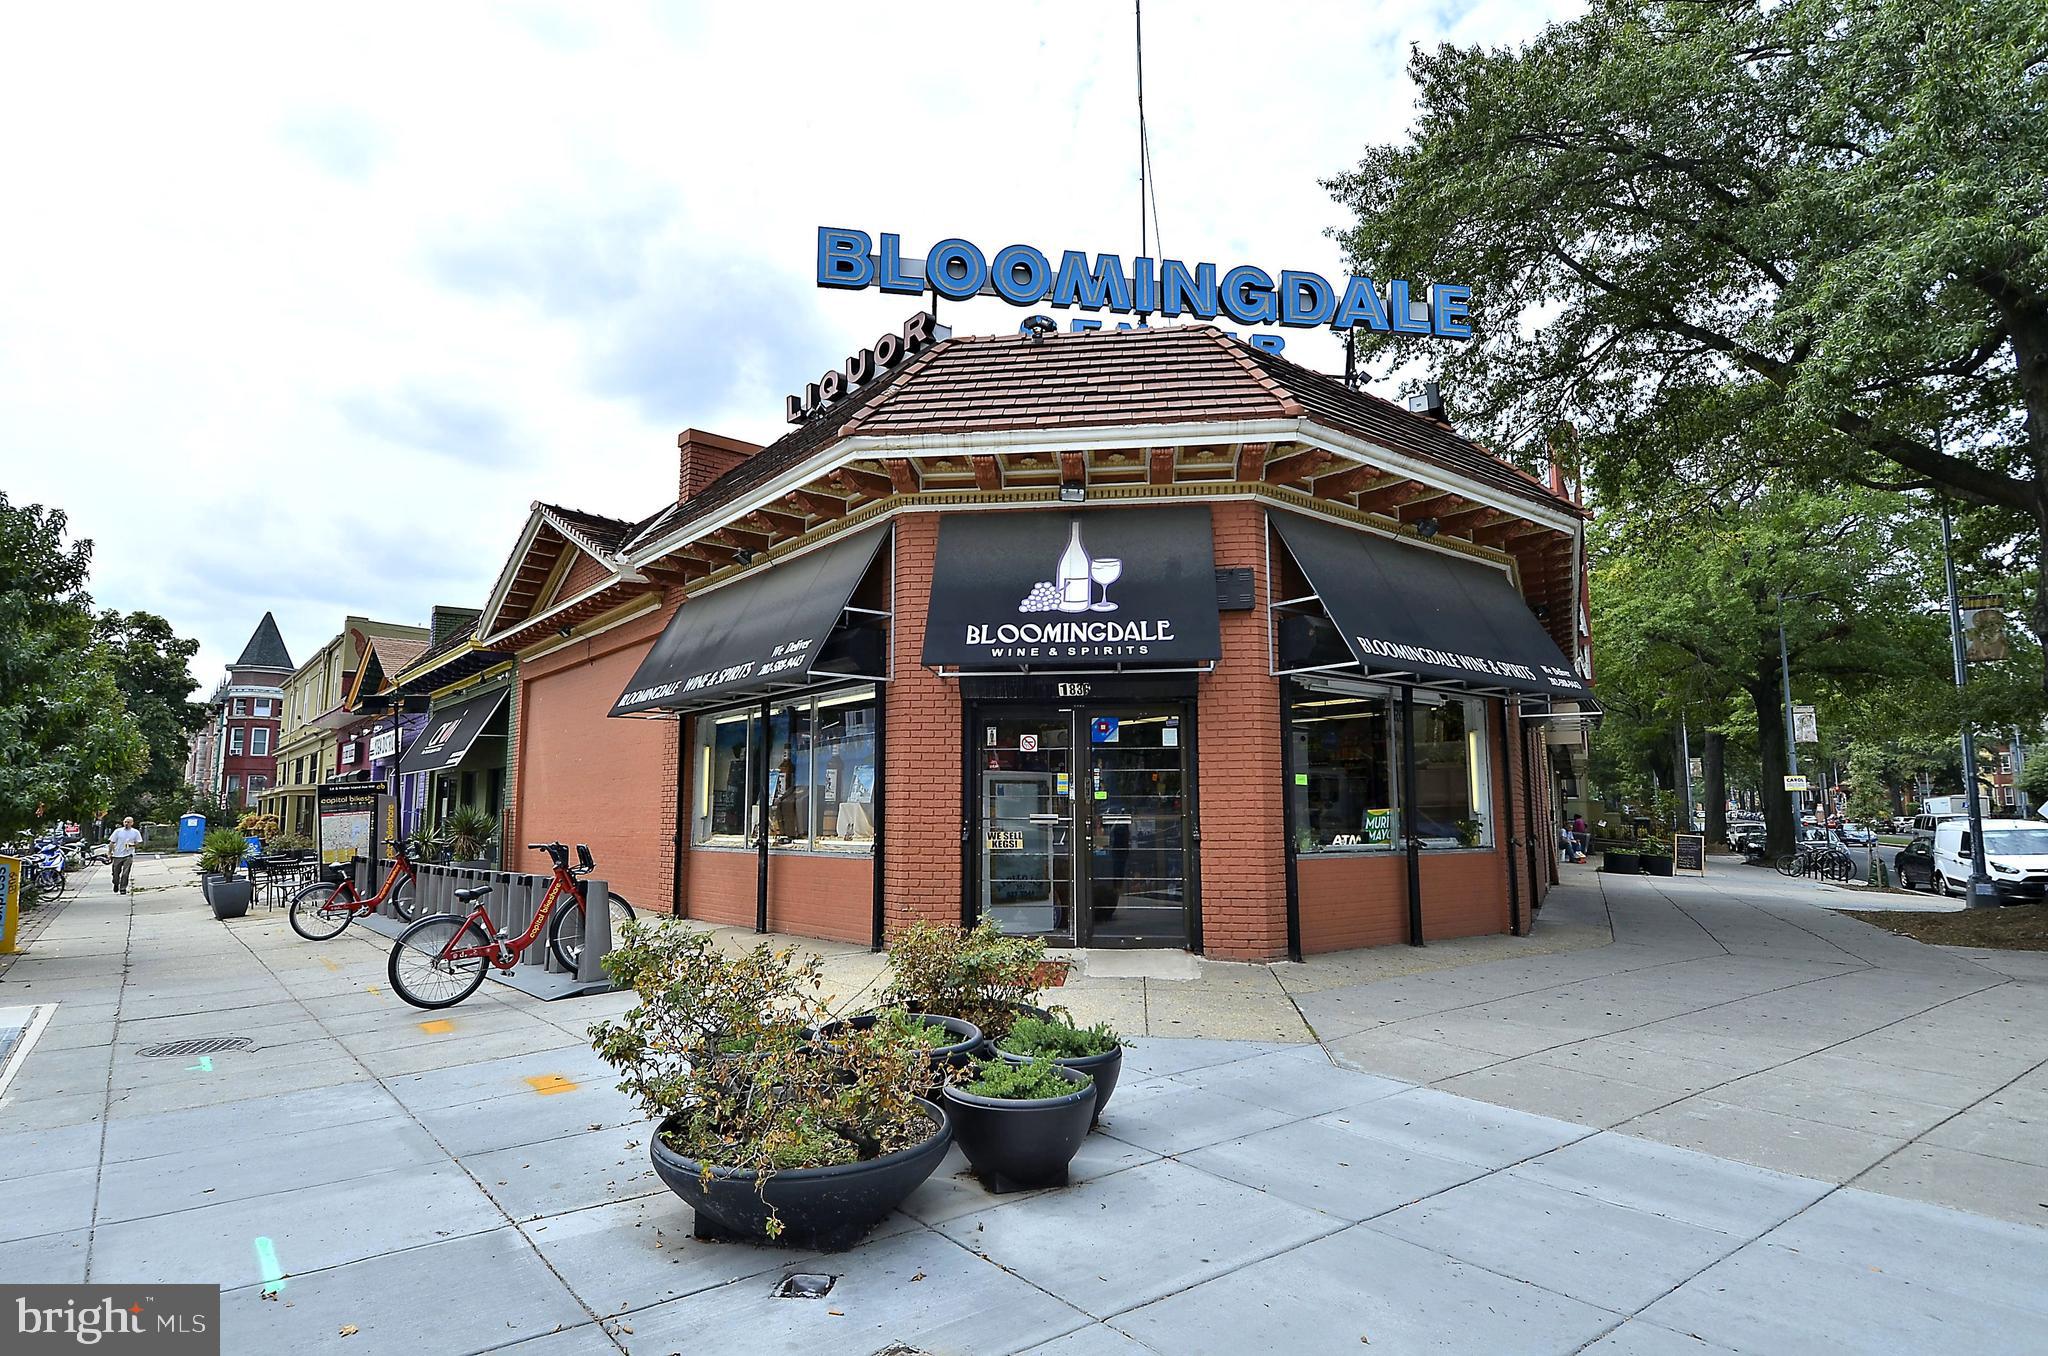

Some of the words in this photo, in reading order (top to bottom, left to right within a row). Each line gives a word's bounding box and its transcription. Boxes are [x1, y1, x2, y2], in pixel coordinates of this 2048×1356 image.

[817, 226, 1471, 340] BLOOMINGDALE
[786, 310, 936, 423] LIQUOR
[965, 620, 1175, 645] BLOOMINGDALE
[991, 648, 1039, 657] WINE
[1048, 647, 1058, 657] &
[1067, 645, 1149, 656] SPIRITS
[1356, 636, 1462, 669] BLOOMINGDALE
[1455, 654, 1493, 674] WINE
[1487, 660, 1500, 675] &
[1496, 661, 1537, 681] SPIRITS
[617, 680, 682, 708] BLOOMINGDALE
[682, 672, 712, 693] WINE
[706, 671, 719, 687] &
[714, 661, 756, 685] SPIRITS
[1058, 682, 1091, 697] 1836
[1365, 816, 1389, 830] MURI
[987, 832, 1002, 840] WE
[1003, 831, 1023, 840] SELL
[1332, 834, 1362, 846] ATM
[1368, 828, 1392, 841] MAYO
[992, 840, 1018, 848] KEGS!
[530, 914, 545, 938] capital
[540, 882, 562, 913] bikeshare
